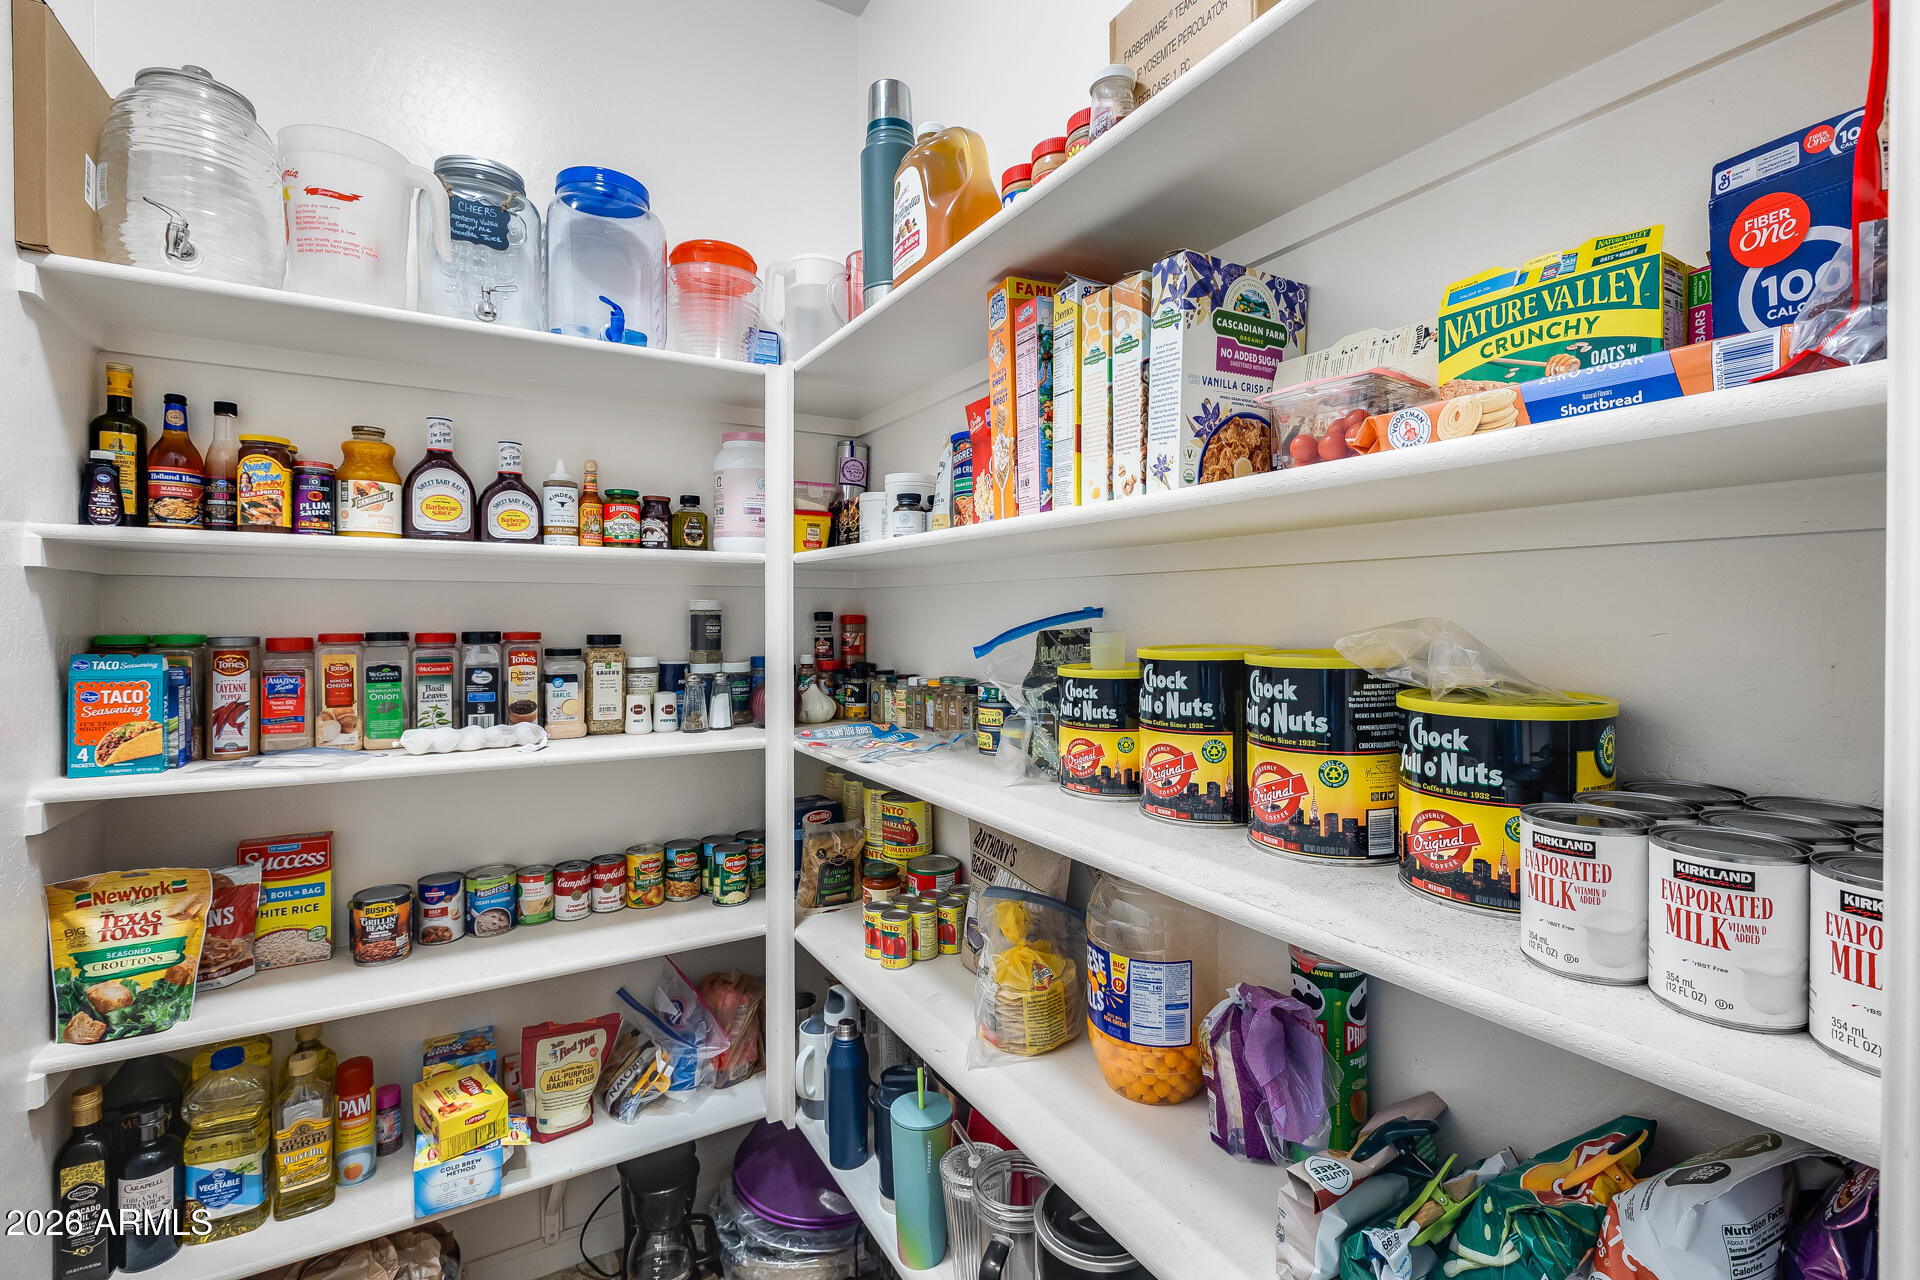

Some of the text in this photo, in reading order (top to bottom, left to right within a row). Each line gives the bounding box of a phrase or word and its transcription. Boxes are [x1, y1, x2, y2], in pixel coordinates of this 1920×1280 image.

[1123, 16, 1168, 64] FARBERWARE
[1143, 0, 1228, 74] YOSEMITE PERCOLATOR
[1808, 130, 1828, 142] FIBER
[458, 201, 497, 217] CHEERS
[1743, 207, 1791, 234] FIBER
[1444, 294, 1538, 356] NATURE
[1541, 262, 1651, 313] VALLEY
[1216, 317, 1286, 341] CASCADIAN FARM
[1239, 335, 1265, 345] ORGANIC
[1480, 315, 1601, 360] CRUNCHY
[1220, 347, 1233, 359] NO
[1233, 350, 1258, 363] ADDED
[1590, 348, 1625, 366] OATS
[1201, 375, 1264, 395] VANILLA CRISP
[1560, 390, 1644, 417] Shortbread
[1391, 410, 1425, 436] VOORTMAN
[151, 472, 180, 482] Holland
[160, 485, 193, 493] MARSALA
[417, 478, 451, 493] SWEET BABY
[214, 492, 230, 500] RED
[507, 497, 521, 505] BABY
[300, 502, 331, 511] PLUM
[300, 508, 331, 517] sauce
[425, 503, 458, 512] Barbecue
[431, 509, 452, 517] Sauce
[609, 505, 639, 514] LA PREFERIDA
[500, 517, 527, 525] Barbecue
[92, 660, 158, 671] TACO Seasoning
[217, 659, 246, 669] Tone's
[510, 655, 536, 664] Tone's
[329, 664, 350, 672] Tone's
[368, 670, 399, 679] McCormick
[518, 669, 536, 677] black
[268, 676, 299, 685] AMAZING
[1143, 663, 1188, 693] Chock
[1249, 670, 1299, 702] Chock
[215, 682, 248, 694] CAYENNE
[422, 690, 448, 700] Leaves
[424, 683, 445, 692] Basil
[1065, 679, 1099, 701] Chock
[100, 689, 144, 704] TACO
[369, 692, 399, 701] Onion
[81, 704, 143, 718] Seasoning
[1082, 700, 1117, 721] Nuts
[1166, 691, 1214, 720] Nuts
[1273, 702, 1328, 734] Nuts
[1409, 716, 1469, 753] Chock
[76, 747, 89, 763] 4
[1067, 750, 1096, 767] Original
[1146, 758, 1186, 781] Original
[1400, 742, 1504, 786] full Nuts
[1252, 780, 1295, 807] Original
[1421, 782, 1490, 800] Coffee Since 1932
[807, 811, 831, 823] Barilla
[1415, 811, 1445, 825] HEAVENLY
[973, 827, 1018, 868] ANTHONY'S
[1413, 826, 1465, 856] Original
[1533, 832, 1594, 852] KIRKLAND
[885, 846, 919, 854] TOMATOES
[244, 851, 327, 873] Success
[1429, 857, 1459, 871] COFFEE
[1524, 848, 1612, 884] EVAPORATED
[1676, 861, 1752, 884] KIRKLAND
[270, 886, 322, 900] BOIL BAG
[476, 883, 509, 898] PROGRESSO
[1527, 870, 1577, 911] MILK
[1574, 886, 1601, 898] VITAMIN
[1580, 896, 1601, 906] ADDED
[1661, 878, 1773, 920] EVAPORATED
[1843, 892, 1883, 912] KIRK
[292, 902, 320, 915] RICE
[365, 904, 395, 916] BUSH'S
[100, 909, 162, 930] TEXAS
[359, 915, 398, 926] GRILLIN'
[365, 923, 395, 932] BEANS
[1665, 903, 1731, 951] MILK
[64, 927, 86, 939] BIG
[97, 922, 163, 943] TOAST
[1728, 922, 1767, 936] VITAMIN D
[1824, 911, 1883, 950] EVAPO
[1734, 933, 1761, 945] ADDED
[106, 947, 152, 959] SEASONED
[92, 954, 164, 972] CROUTONS
[1112, 960, 1126, 971] BIG
[1712, 965, 1729, 974] Free
[1830, 940, 1883, 991] MIL
[1666, 970, 1696, 990] 354 mL
[1665, 980, 1708, 1005] (12 FL OZ)
[546, 1073, 595, 1091] BAKING FLOUR
[548, 1066, 595, 1083] ALL-PURPOSE
[461, 1077, 482, 1096] LIPTON
[338, 1094, 371, 1119] PAM
[465, 1113, 486, 1125] LIPTON
[279, 1135, 327, 1153] BERIO
[283, 1147, 324, 1166] OLIVE OIL
[440, 1157, 482, 1174] COLD BREW
[446, 1164, 477, 1178] METHOD
[1310, 1162, 1344, 1176] FREE
[1319, 1168, 1351, 1184] GLUTEN
[198, 1179, 241, 1193] VEGETABLE
[1723, 1215, 1766, 1237] Nutrition
[1732, 1261, 1764, 1278] Calories
